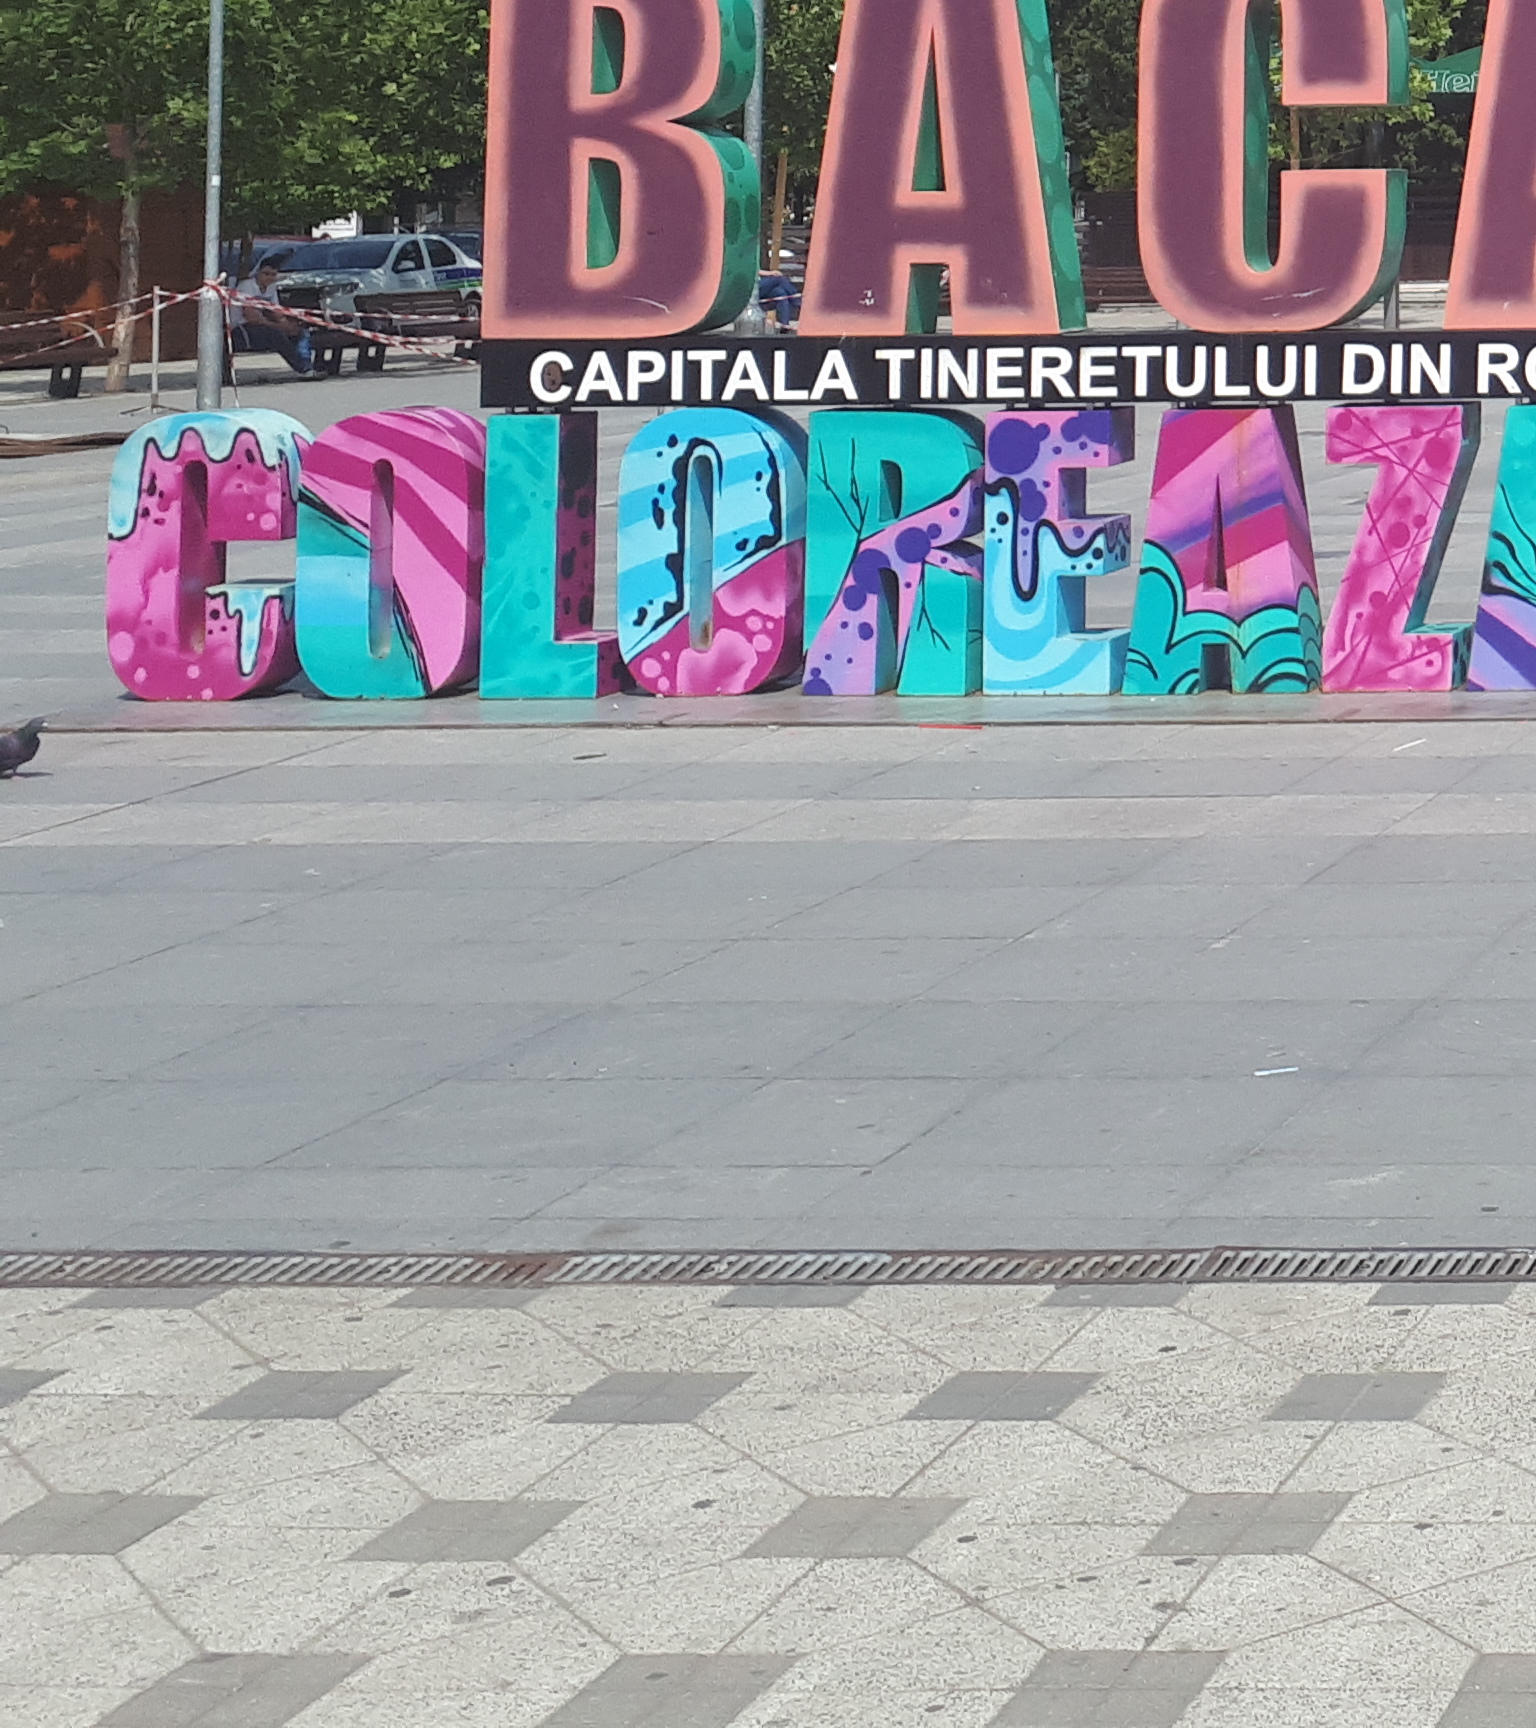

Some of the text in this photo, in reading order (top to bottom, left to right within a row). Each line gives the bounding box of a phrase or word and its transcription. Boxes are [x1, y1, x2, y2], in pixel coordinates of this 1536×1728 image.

[529, 349, 858, 403] CAPITALA
[876, 344, 1317, 399] TINERETULUI
[1342, 343, 1451, 396] DIN
